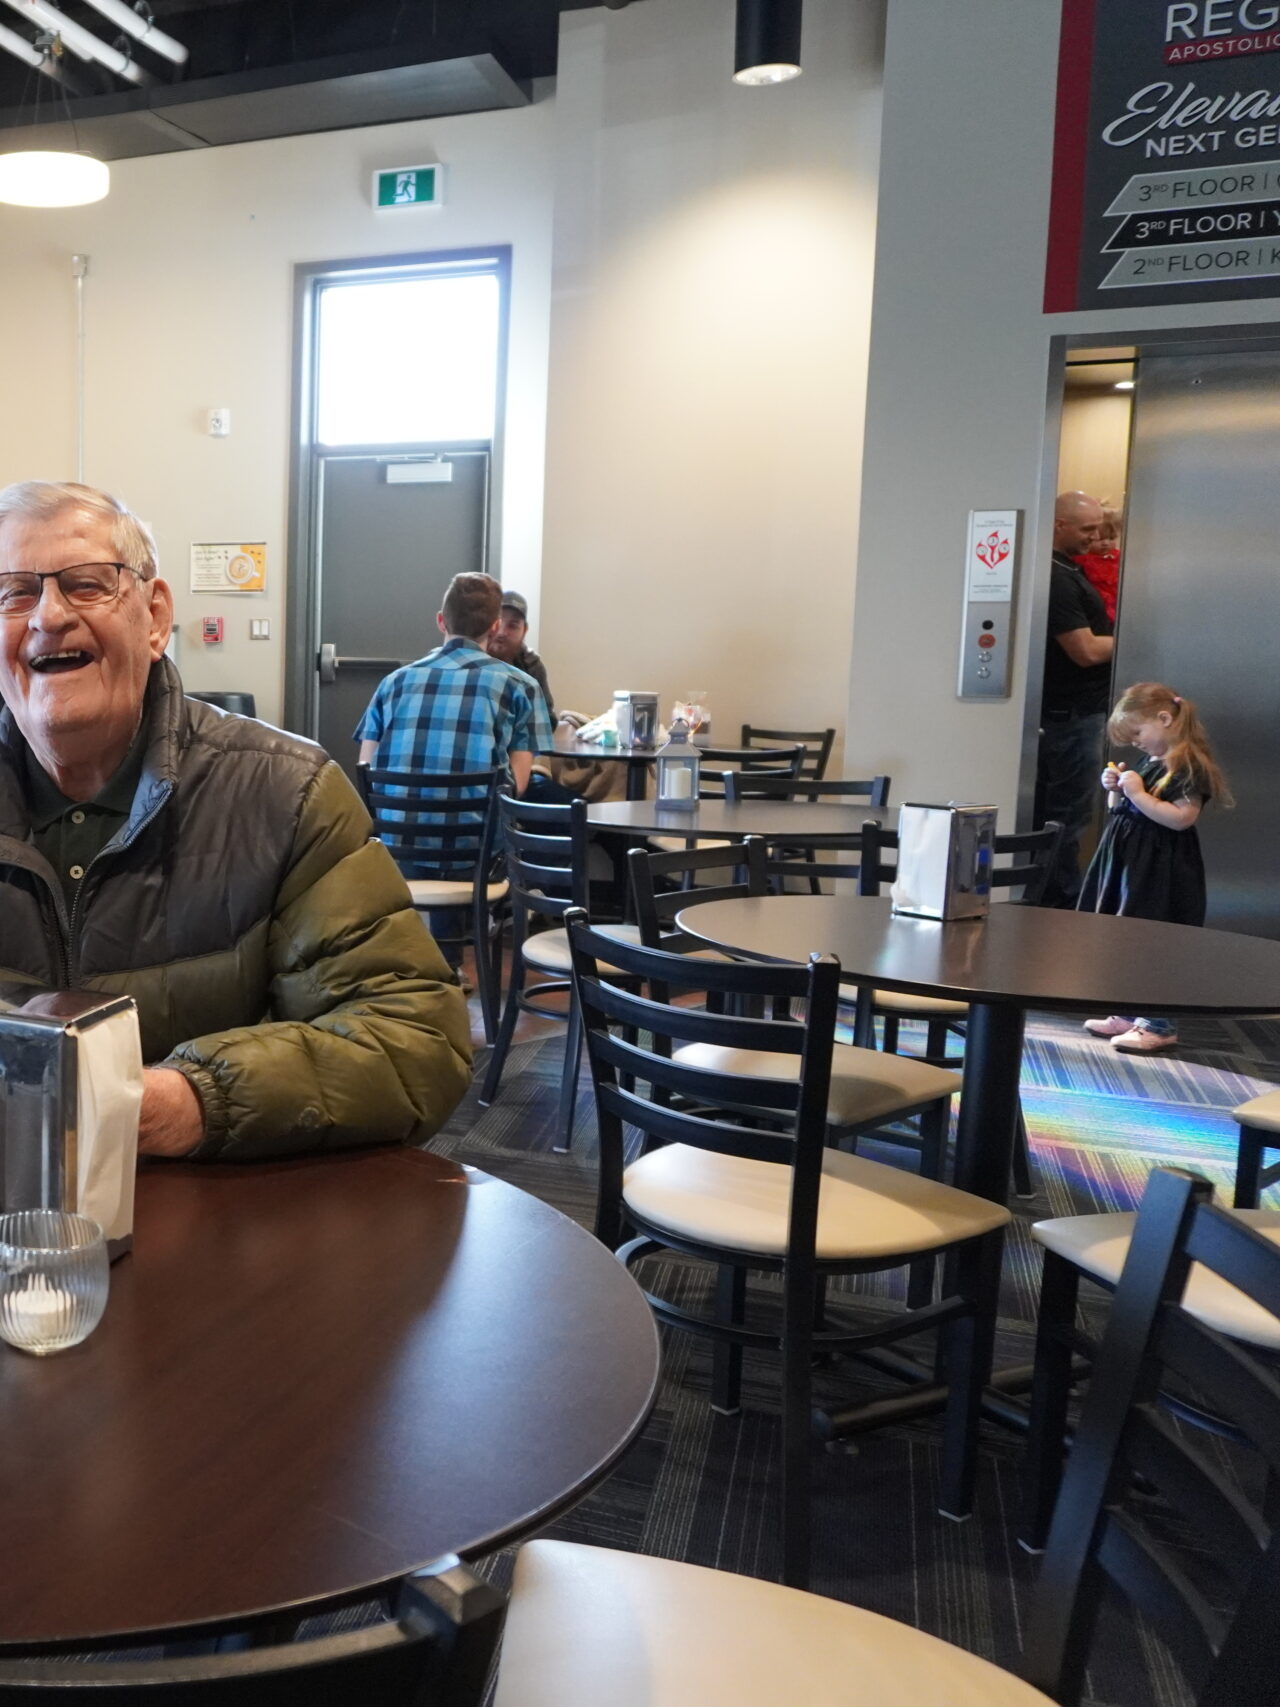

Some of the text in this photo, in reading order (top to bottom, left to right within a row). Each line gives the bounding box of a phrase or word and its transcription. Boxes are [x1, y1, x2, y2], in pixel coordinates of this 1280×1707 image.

[1165, 0, 1280, 42] REG
[1168, 34, 1280, 61] APOSTOLIC
[1145, 124, 1280, 158] NEXT GE
[1172, 175, 1255, 198] FLOOR
[1169, 212, 1252, 236] FLOOR
[1168, 250, 1250, 273] FLOOR
